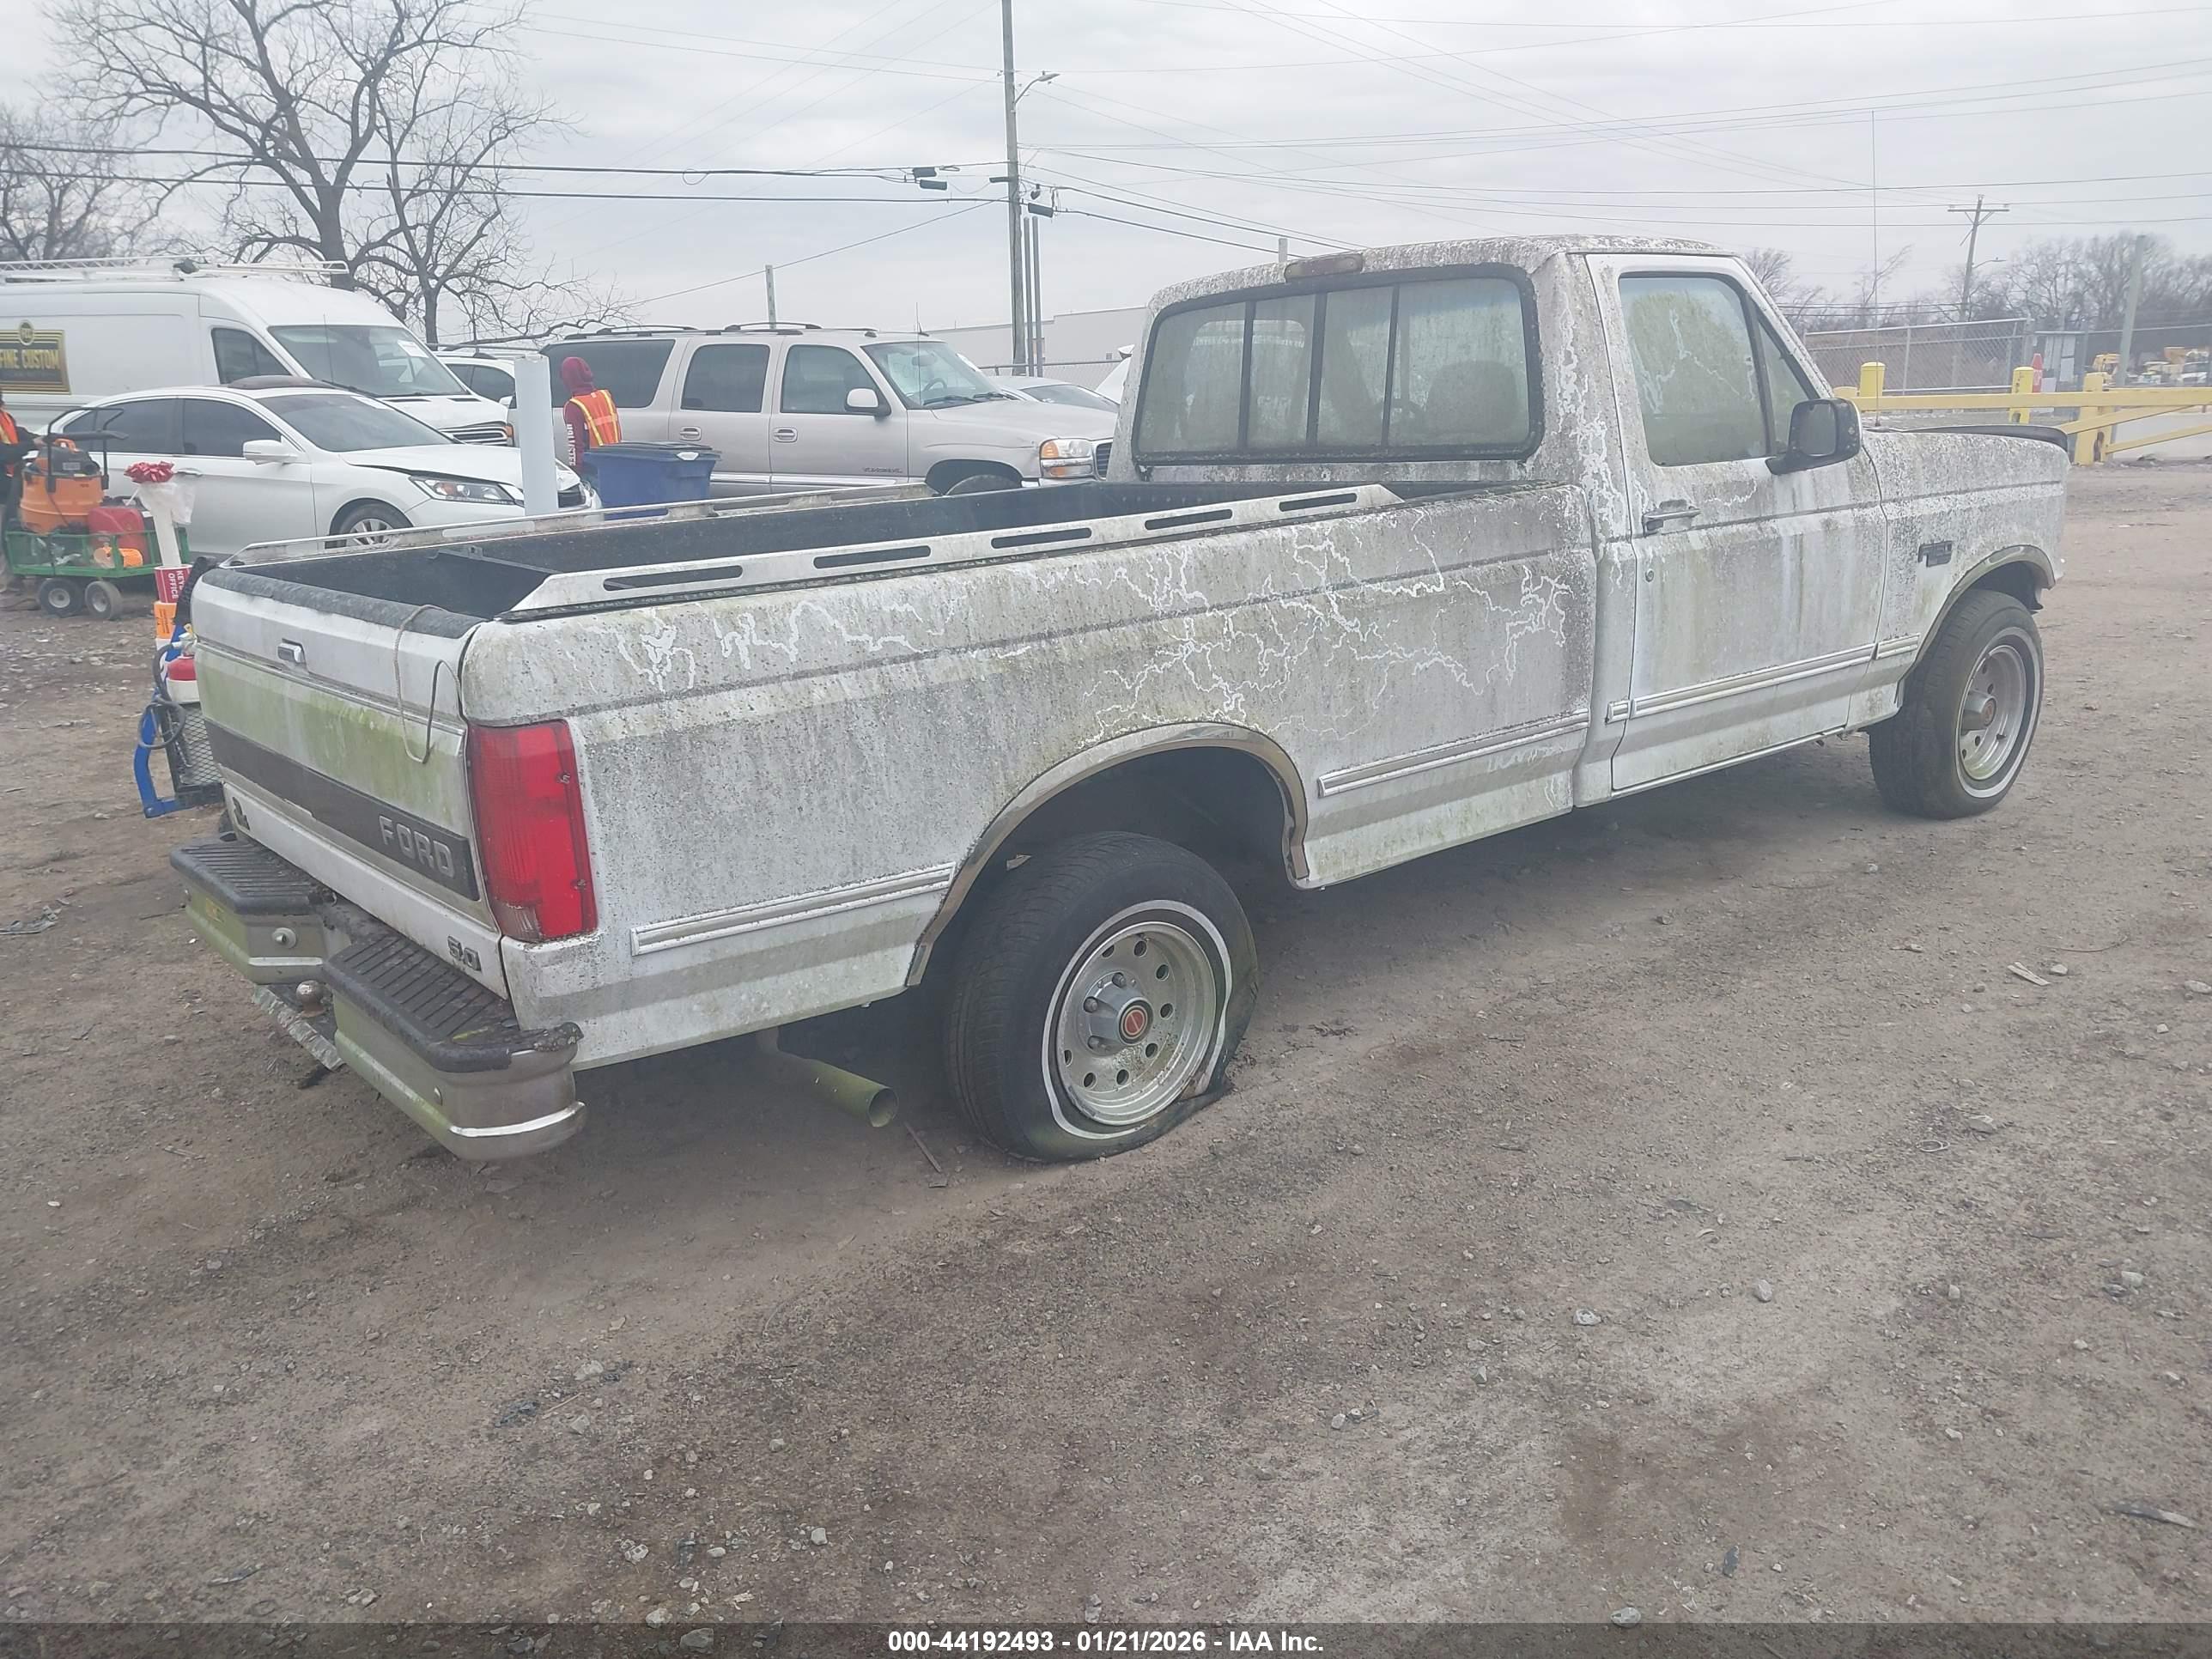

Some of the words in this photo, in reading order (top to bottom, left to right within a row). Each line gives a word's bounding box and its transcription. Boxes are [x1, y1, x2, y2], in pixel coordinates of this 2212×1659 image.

[21, 349, 59, 369] CUSTOM
[167, 573, 179, 599] OFFICE
[379, 815, 455, 878] FORD
